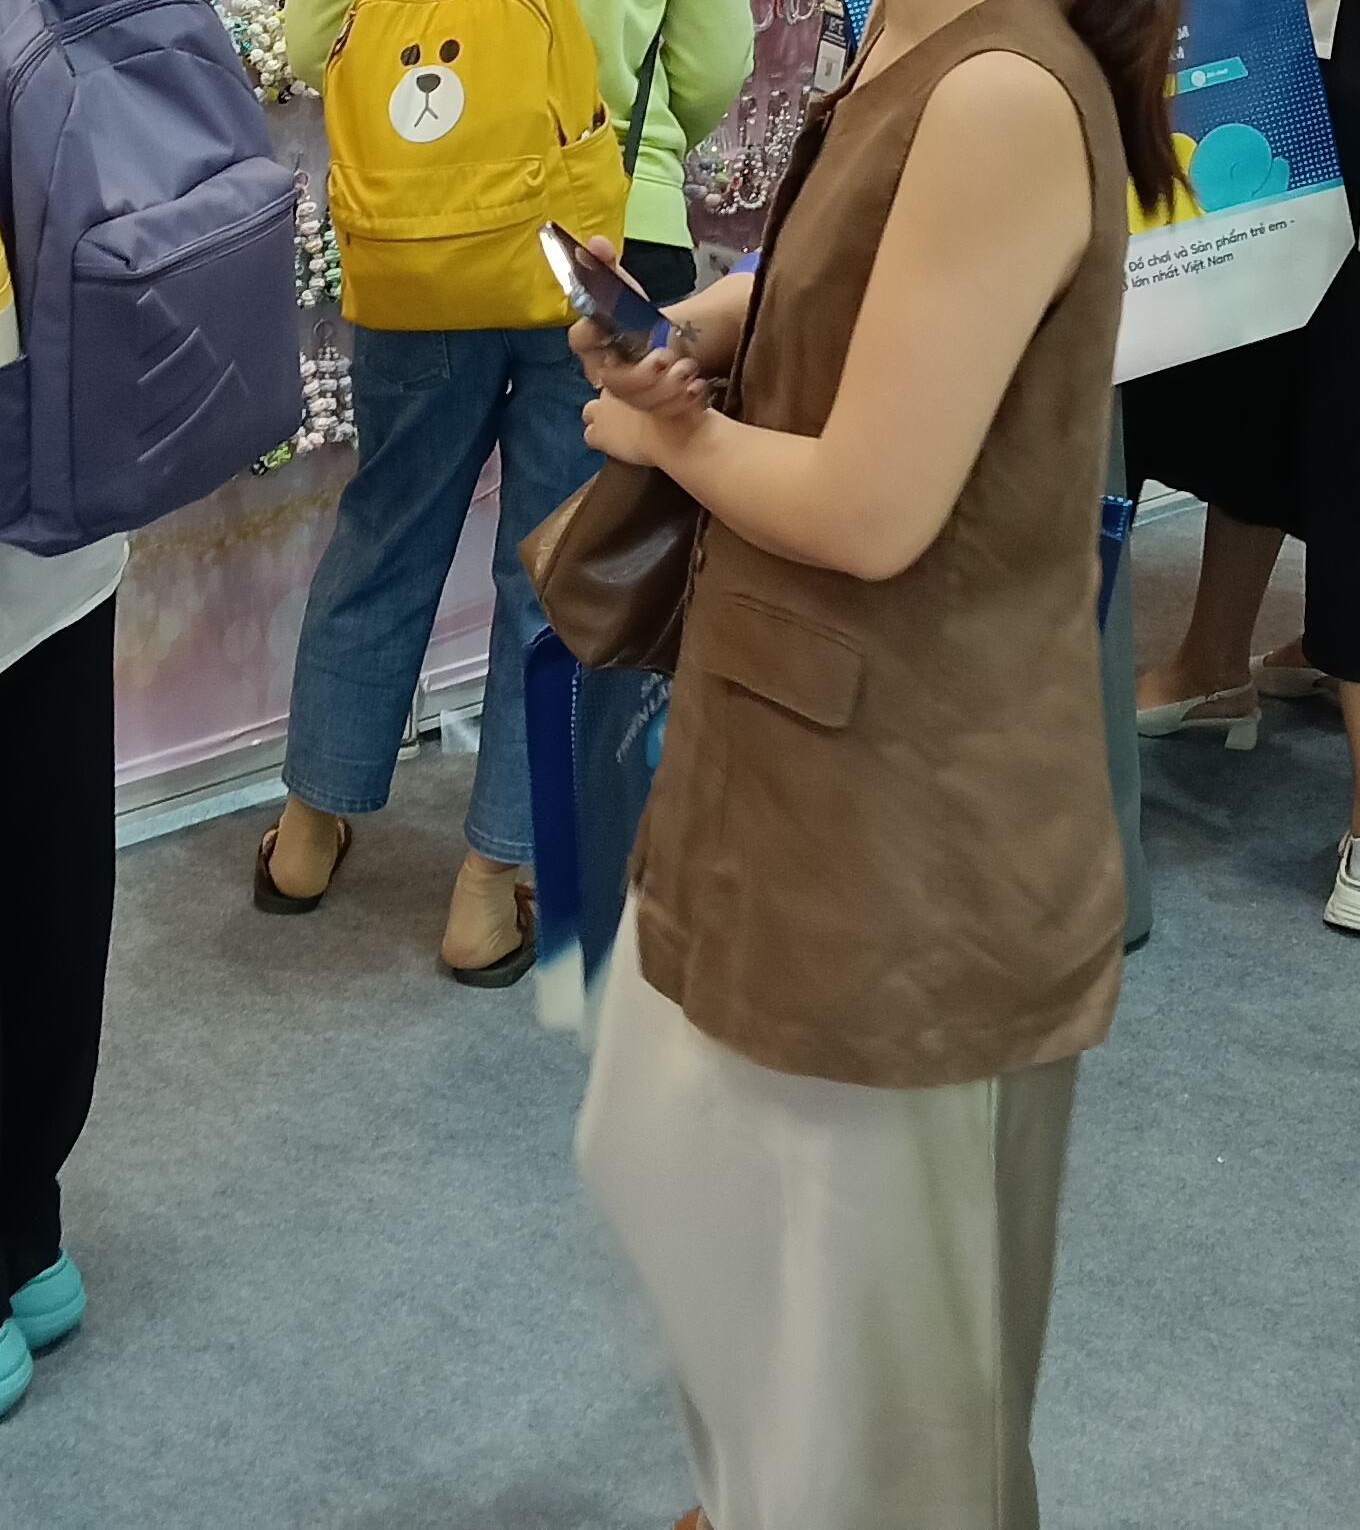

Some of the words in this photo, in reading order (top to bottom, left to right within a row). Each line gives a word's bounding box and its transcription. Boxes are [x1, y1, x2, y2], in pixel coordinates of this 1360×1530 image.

[1174, 246, 1188, 259] và
[1268, 220, 1288, 232] em
[1207, 253, 1234, 267] Nam
